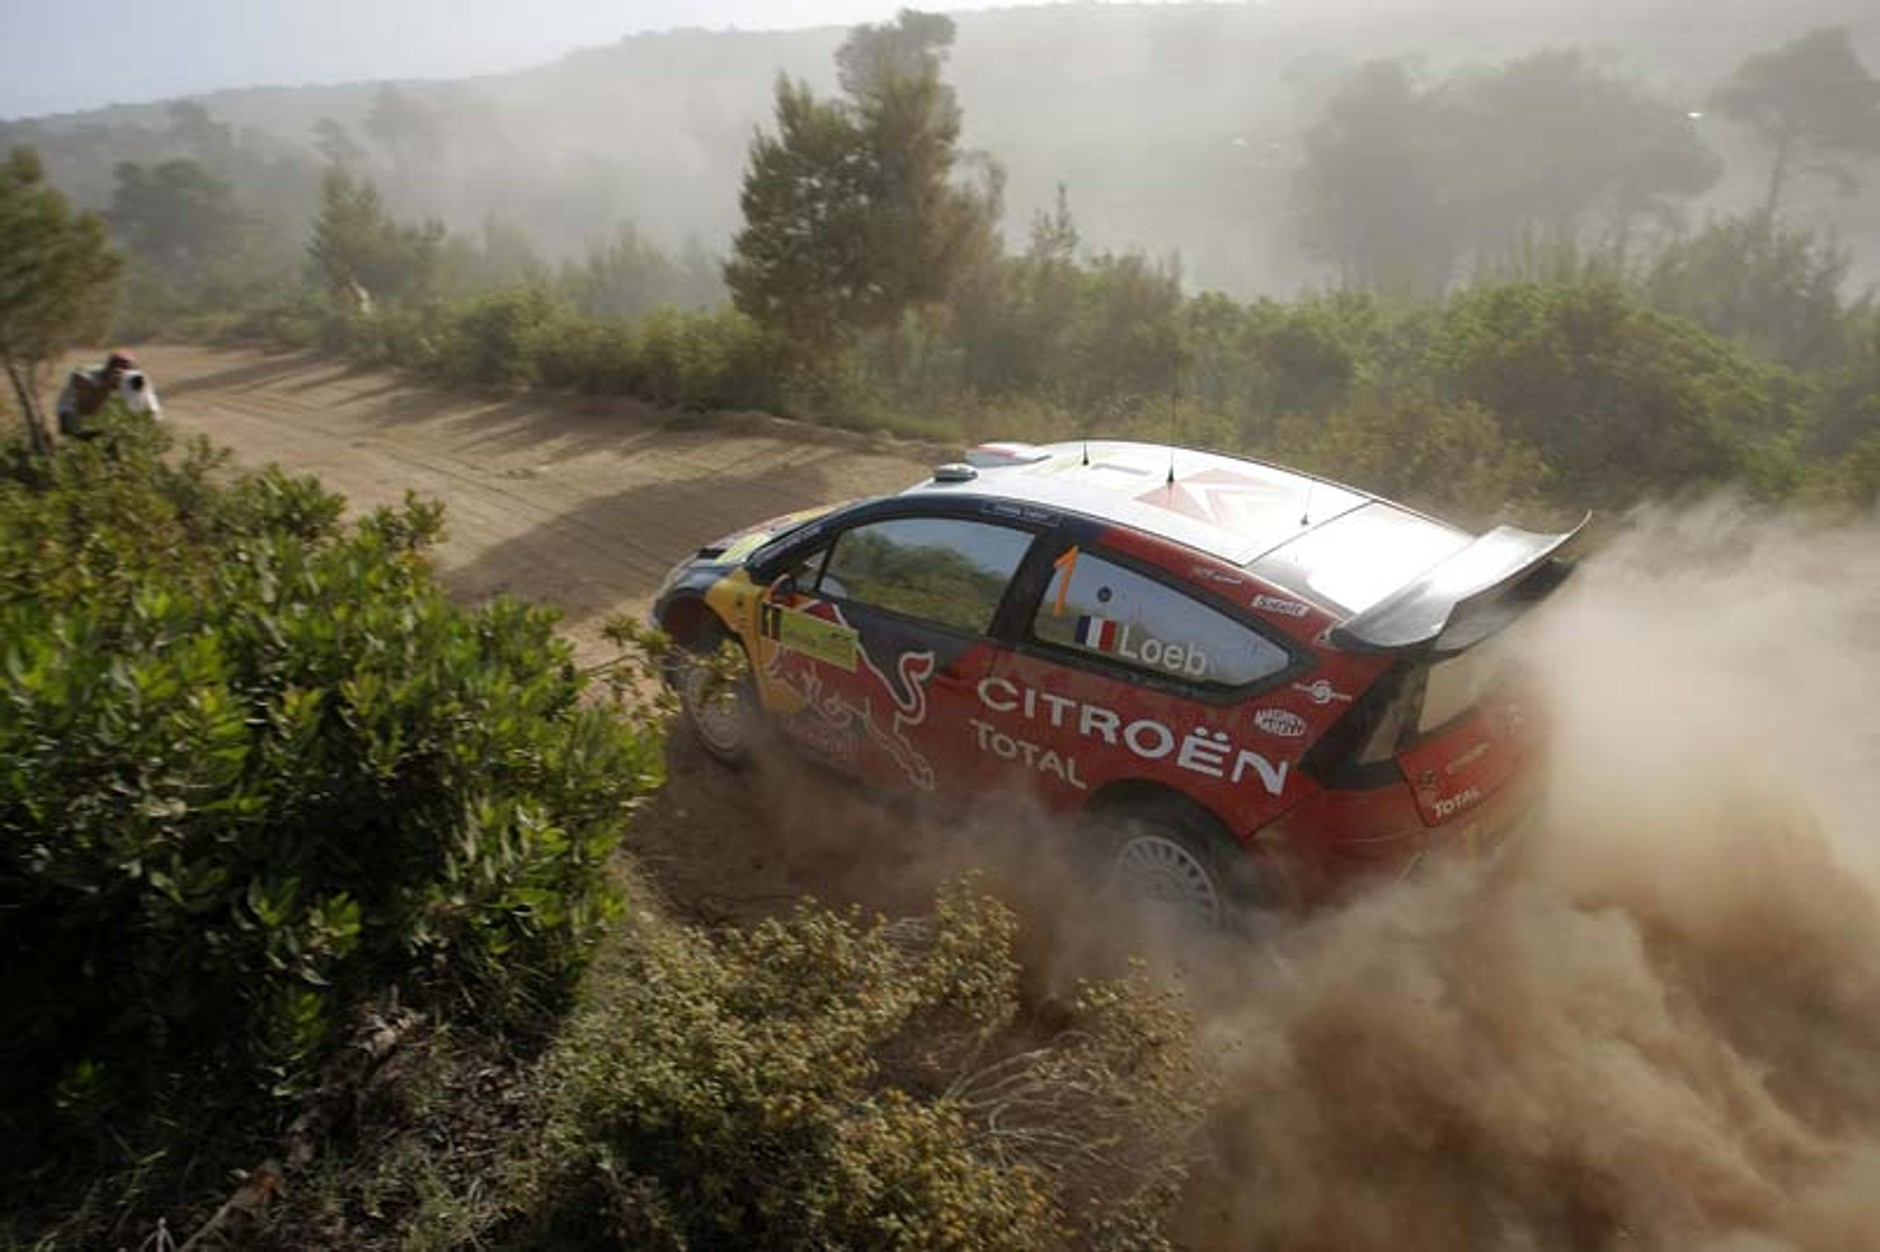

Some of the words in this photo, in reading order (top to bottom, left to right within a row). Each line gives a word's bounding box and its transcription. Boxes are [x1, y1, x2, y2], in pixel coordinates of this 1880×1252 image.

[1053, 545, 1079, 617] 1
[1119, 624, 1207, 675] Loeb
[969, 718, 1087, 789] TOTAL
[977, 676, 1288, 795] CITROËN
[1431, 787, 1483, 818] TOTAL
